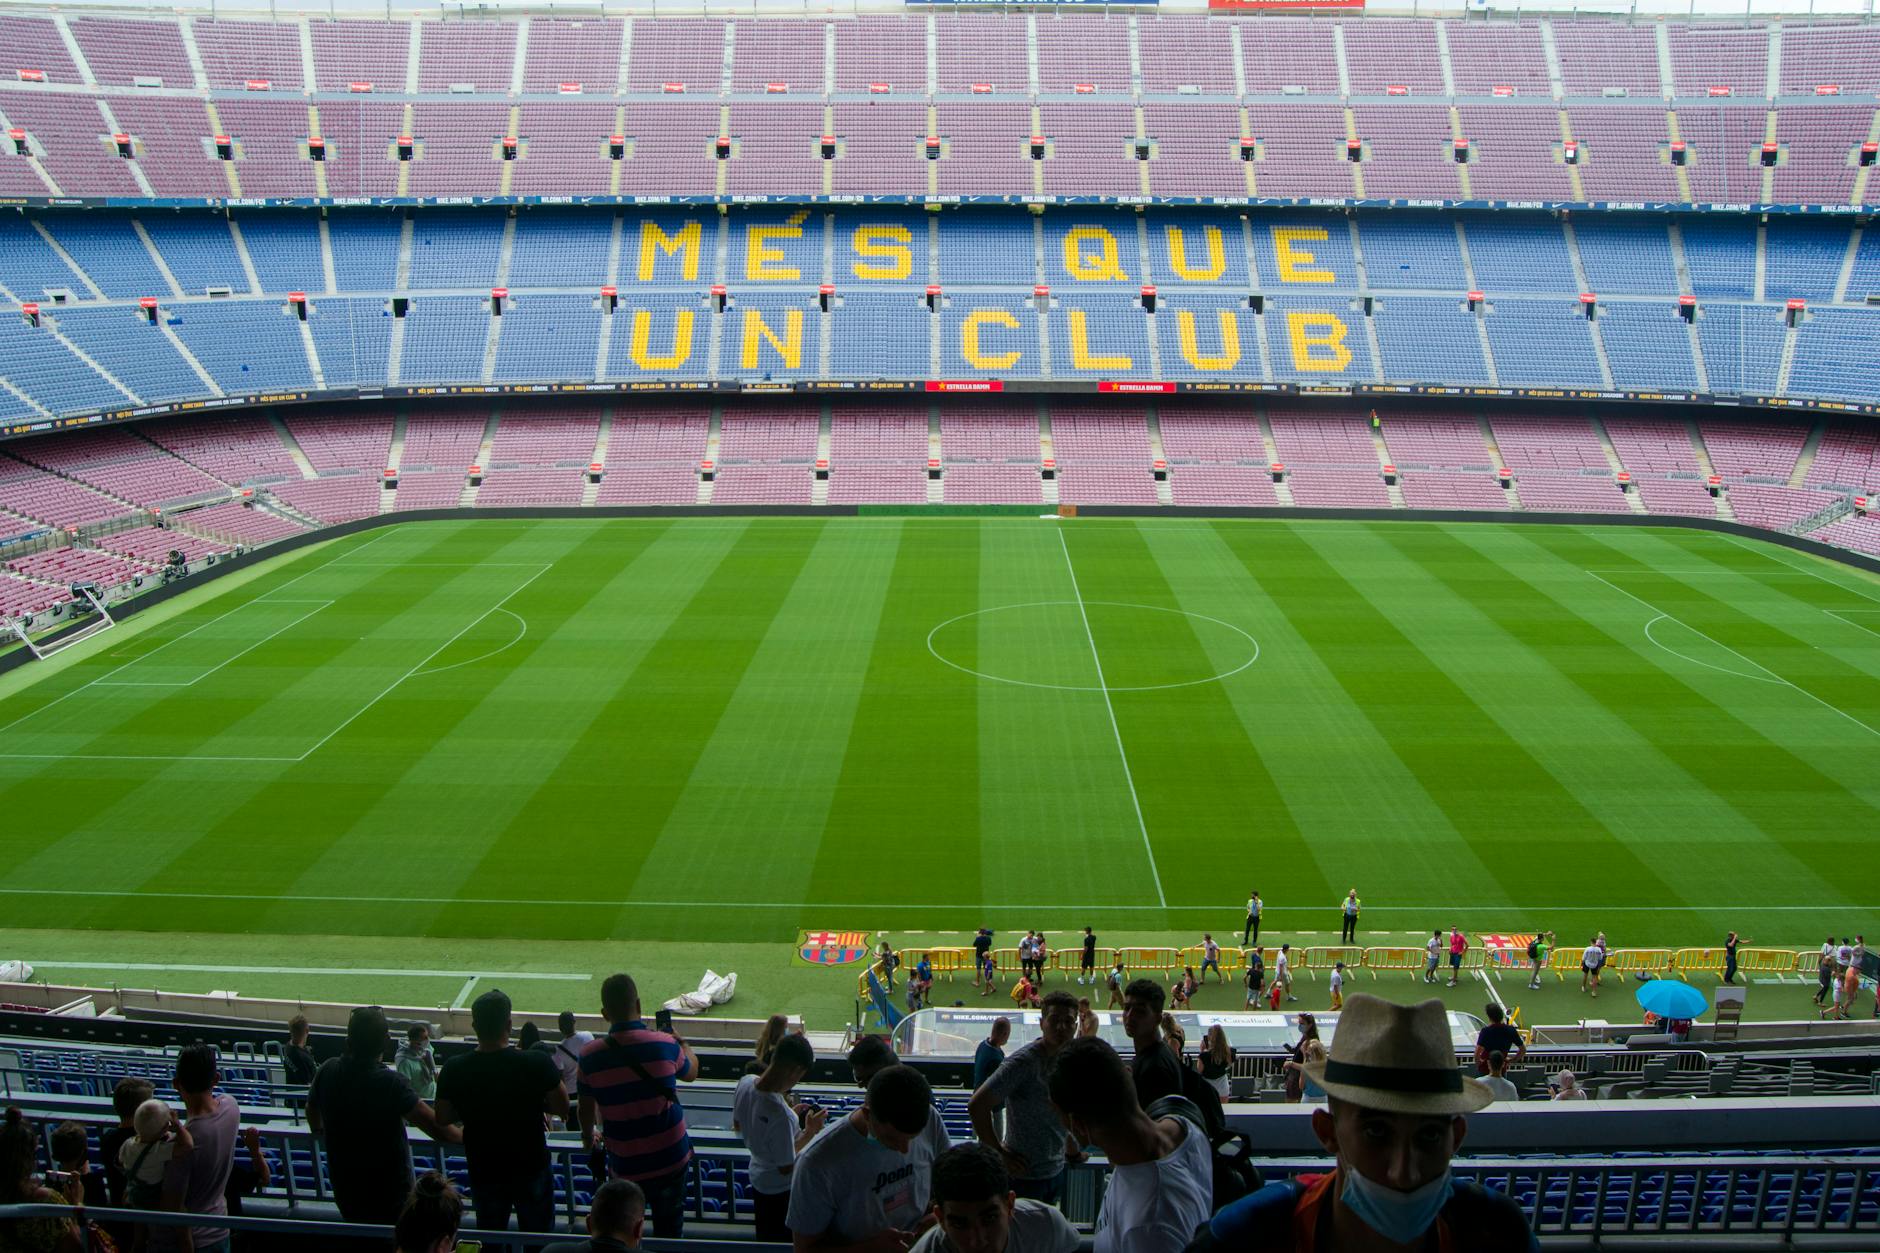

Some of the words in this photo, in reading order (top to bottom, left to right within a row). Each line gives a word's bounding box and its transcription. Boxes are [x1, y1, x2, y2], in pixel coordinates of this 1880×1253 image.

[638, 207, 913, 281] MÉS
[1063, 226, 1336, 283] QUE
[630, 309, 803, 370] UN
[962, 311, 1352, 372] CLUB
